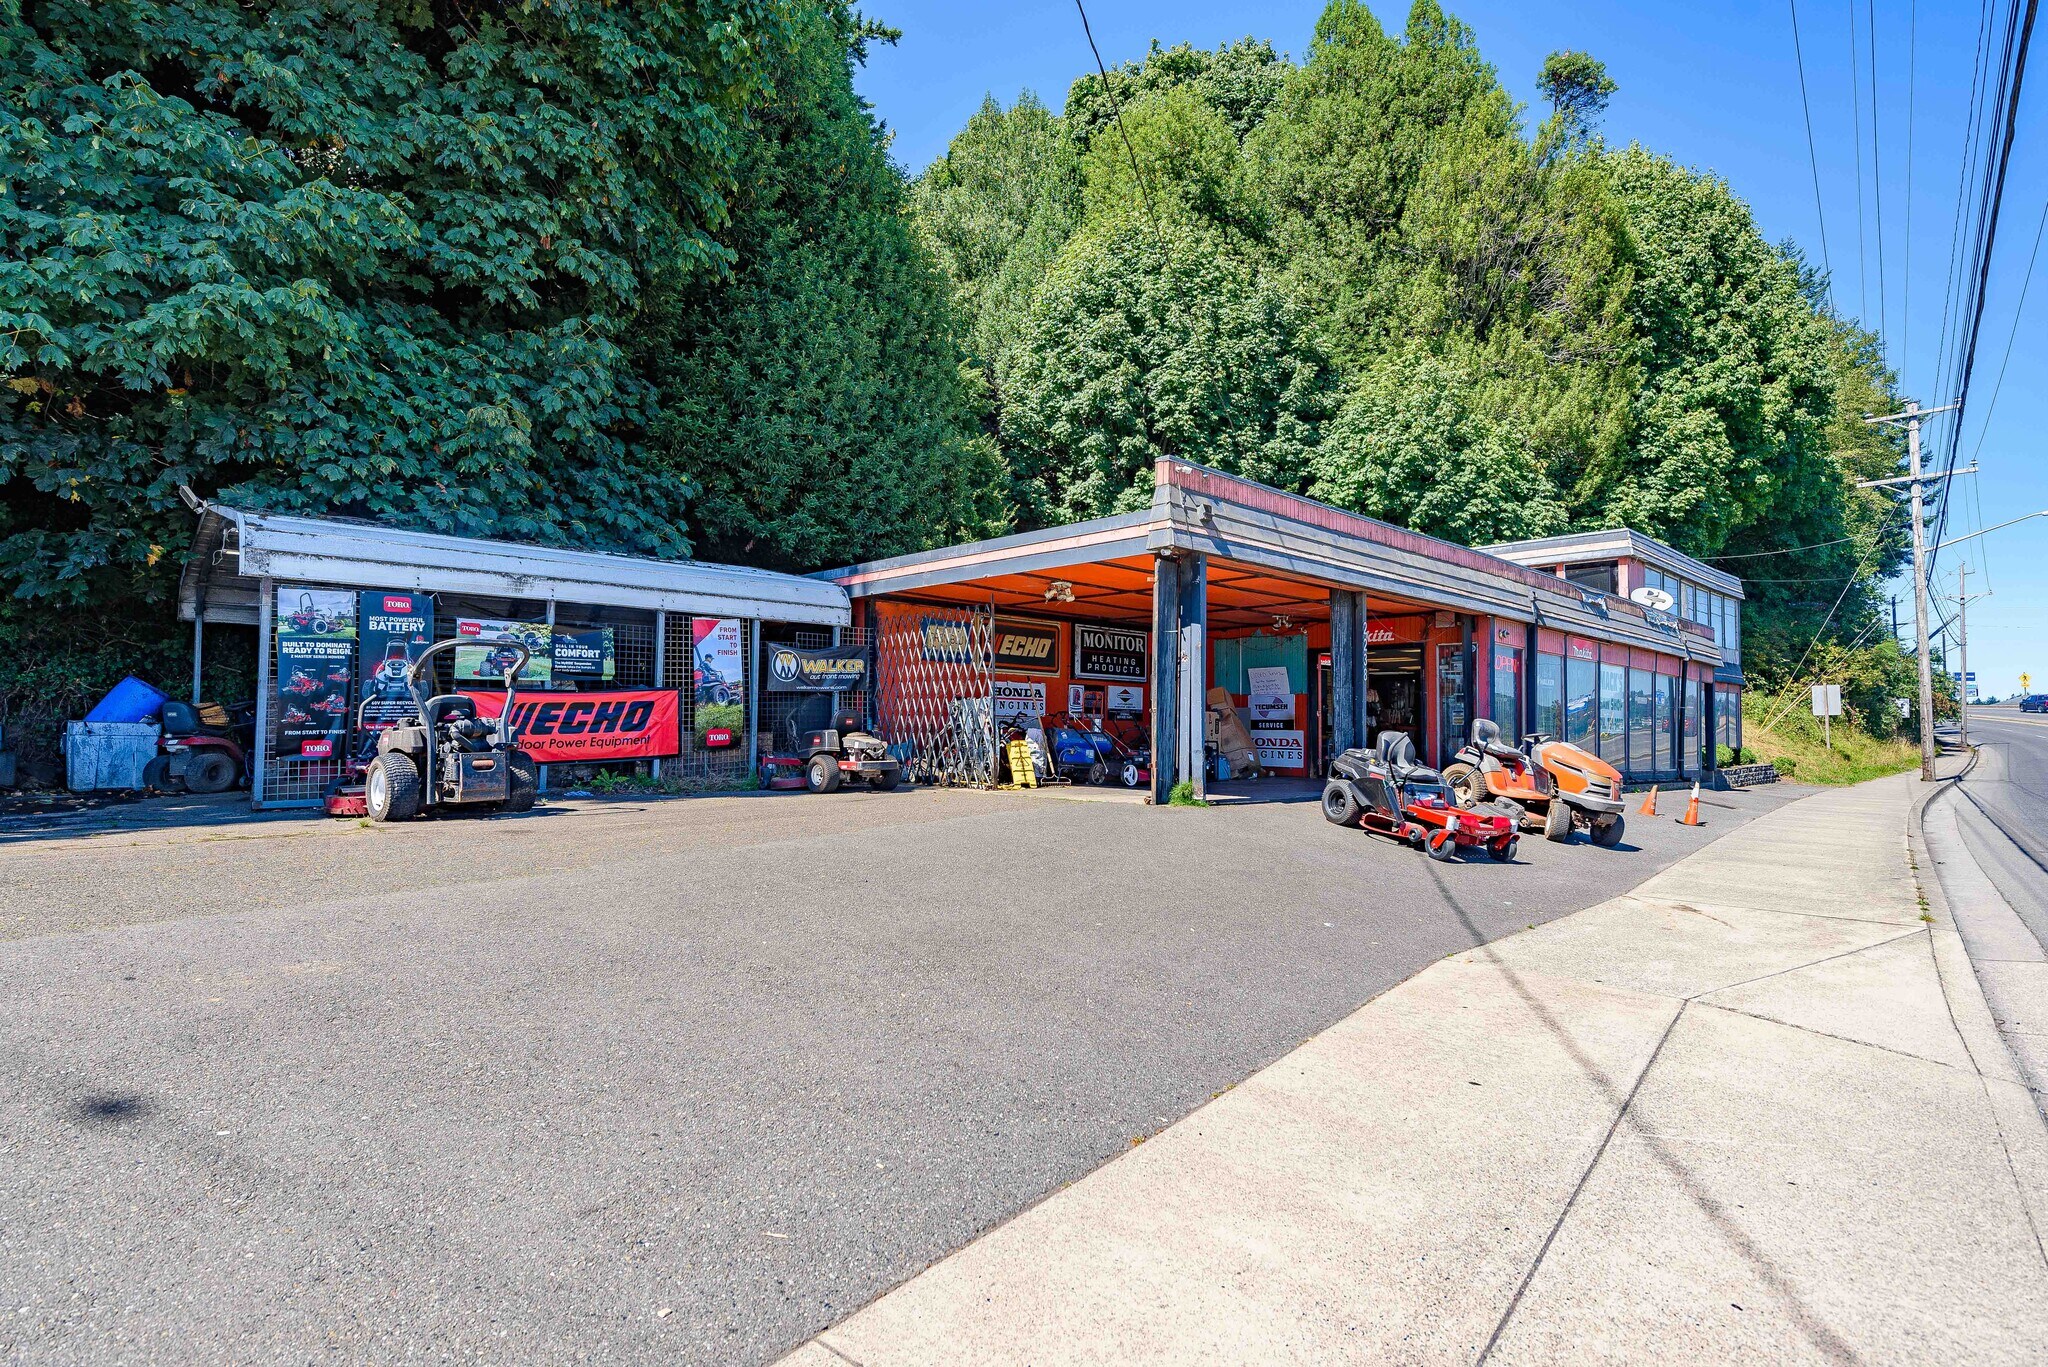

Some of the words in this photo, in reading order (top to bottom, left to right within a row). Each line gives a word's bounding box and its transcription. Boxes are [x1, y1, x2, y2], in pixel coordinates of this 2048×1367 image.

[368, 621, 425, 632] BATTERY
[1366, 630, 1395, 642] kita
[999, 634, 1052, 658] ECHO
[1083, 632, 1145, 653] MONITOR
[555, 648, 600, 658] COMFORT
[1092, 655, 1136, 666] HEATING
[1495, 655, 1518, 673] OPEN
[801, 659, 865, 674] WALKER
[1087, 663, 1140, 674] PRODUCTS
[999, 700, 1044, 711] NGINES
[529, 701, 655, 735] ECHO
[549, 737, 589, 749] Power
[590, 734, 651, 749] Equipment
[1252, 737, 1302, 747] ONDA
[1260, 750, 1303, 759] GINES
